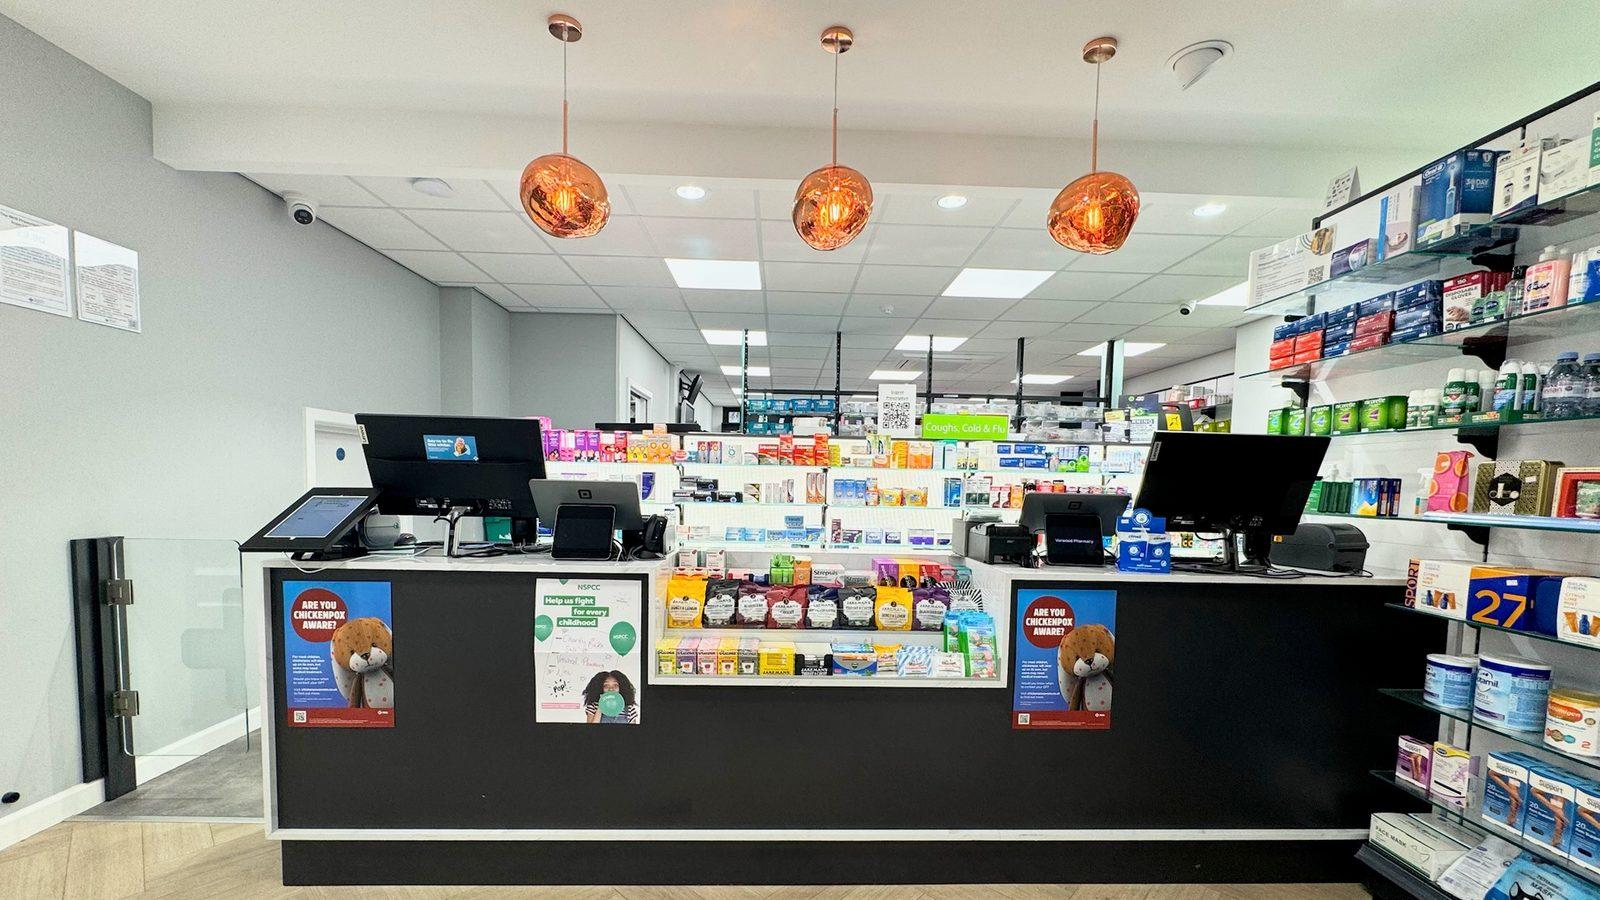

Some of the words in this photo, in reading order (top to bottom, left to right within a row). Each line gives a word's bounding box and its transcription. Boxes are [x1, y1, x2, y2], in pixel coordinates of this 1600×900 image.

[1445, 286, 1478, 298] DISPOSABLE
[962, 423, 981, 433] Cold
[983, 424, 991, 433] &
[992, 424, 1005, 434] Flu
[1404, 559, 1420, 608] SPORT
[302, 600, 319, 610] ARE
[319, 600, 337, 610] YOU
[545, 596, 563, 605] Help
[575, 596, 594, 606] fight
[573, 608, 584, 616] for
[1033, 608, 1049, 617] ARE
[1050, 608, 1066, 617] YOU
[1471, 589, 1527, 628] 27
[293, 610, 346, 620] CHICKENPOX
[302, 620, 337, 630] AWARE?
[558, 619, 596, 627] childhood
[1025, 617, 1073, 626] CHICKENPOX
[1033, 627, 1065, 636] AWARE?
[1404, 742, 1422, 754] Support
[1581, 740, 1592, 749] 2
[1495, 762, 1518, 776] Support
[1487, 782, 1496, 791] 20
[1538, 779, 1563, 795] Support
[1529, 800, 1539, 809] 20
[1575, 820, 1586, 830] 20
[1375, 825, 1390, 839] FACE
[1390, 834, 1407, 848] MASK
[1530, 881, 1555, 899] MASK
